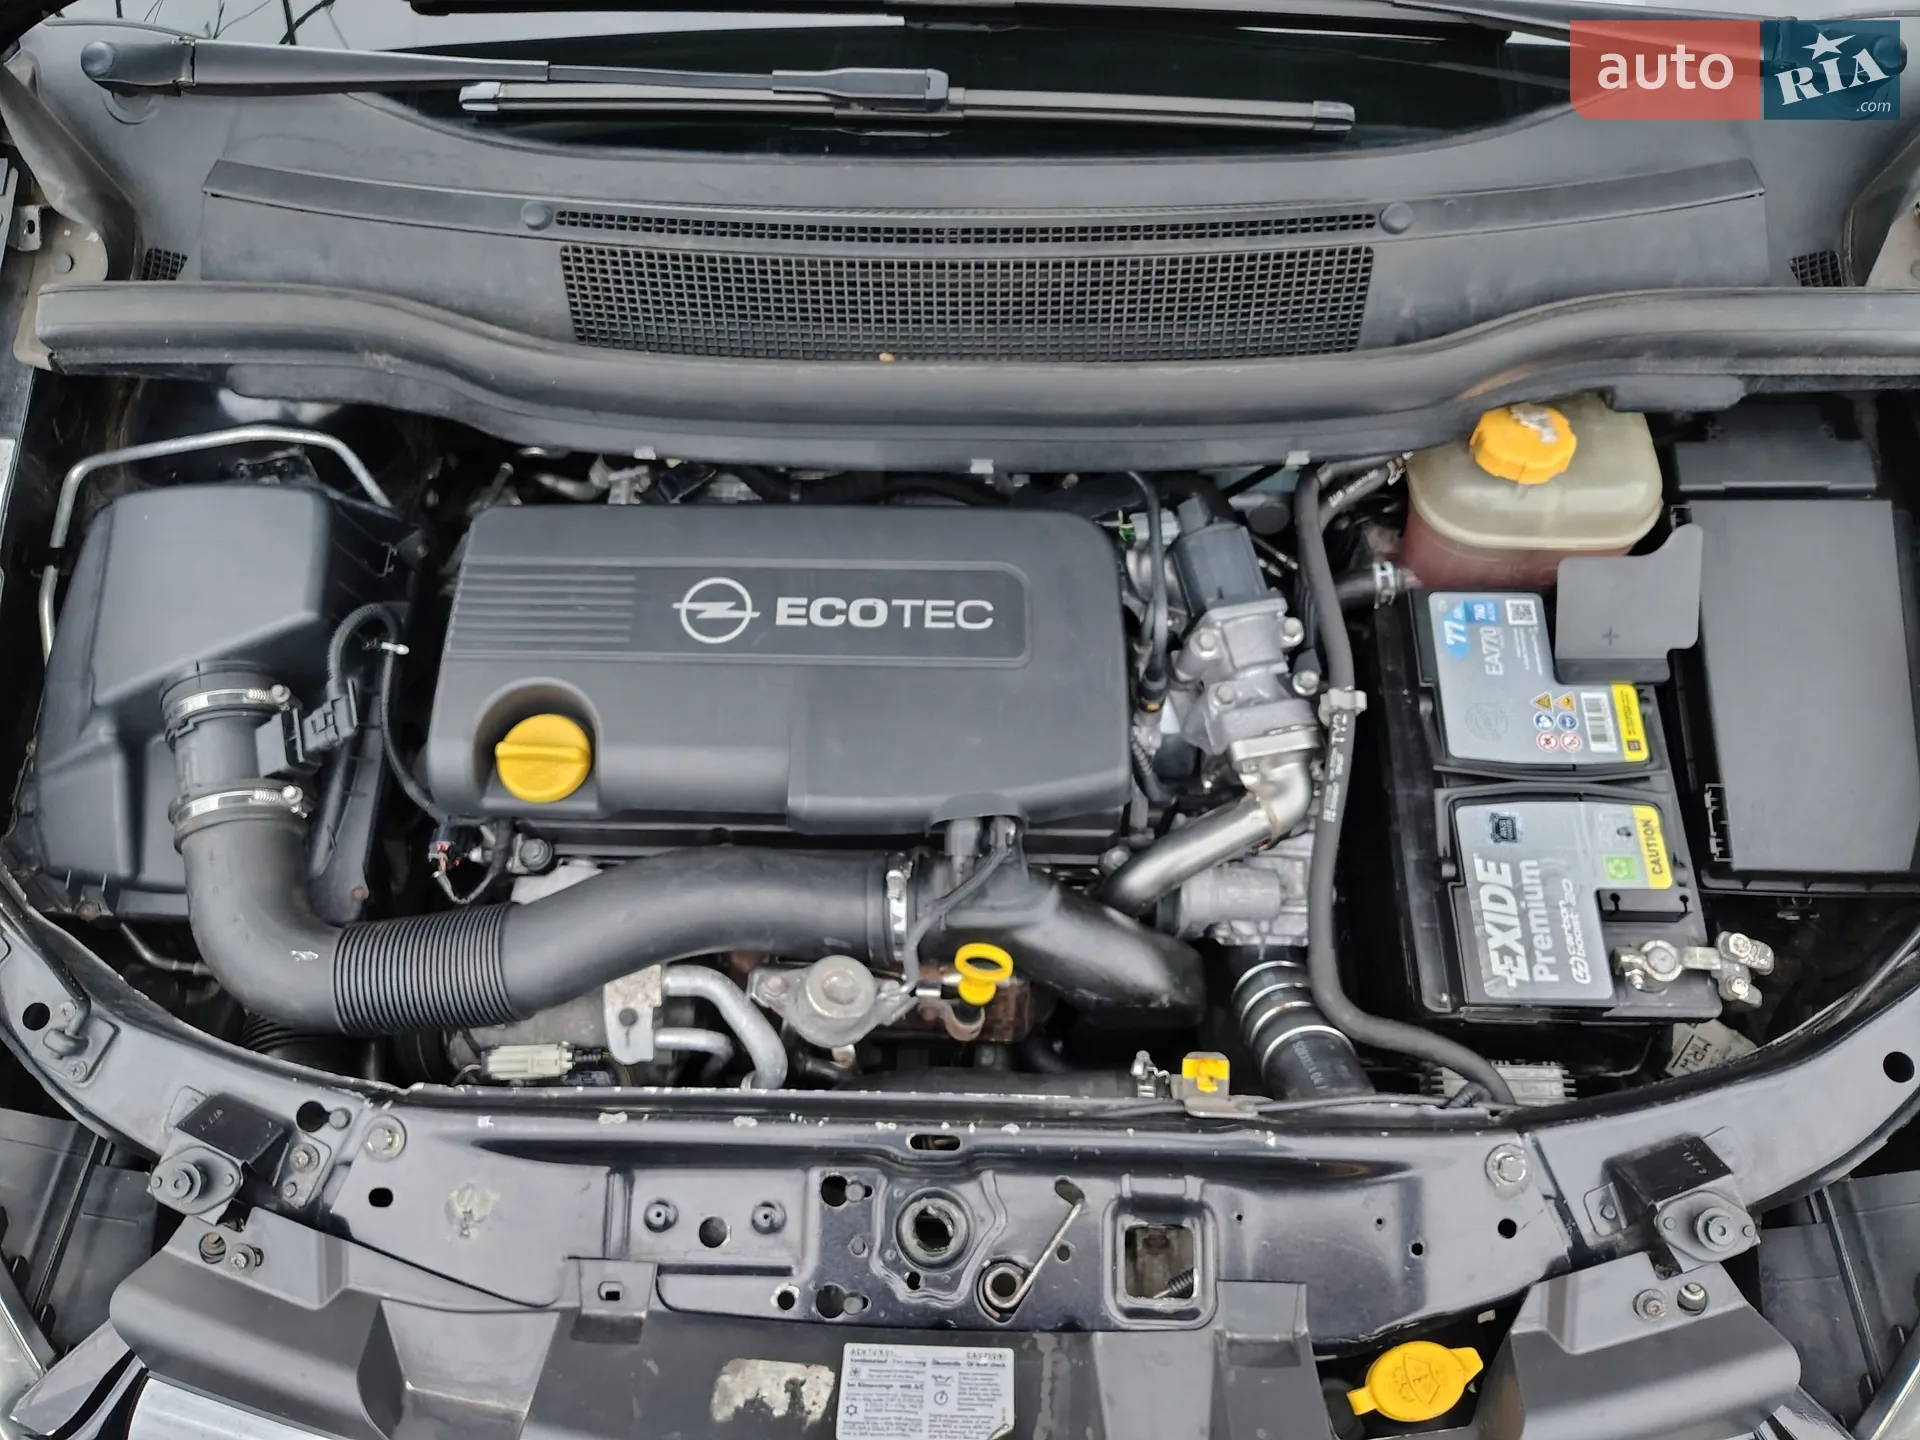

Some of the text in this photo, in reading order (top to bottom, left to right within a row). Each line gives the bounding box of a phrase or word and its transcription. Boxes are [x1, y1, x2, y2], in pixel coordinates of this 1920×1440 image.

[775, 596, 994, 630] ECOTEC
[1443, 620, 1467, 646] 77
[1640, 819, 1663, 875] CAUTION
[1474, 857, 1530, 988] EXIDE
[1519, 859, 1560, 983] Premium
